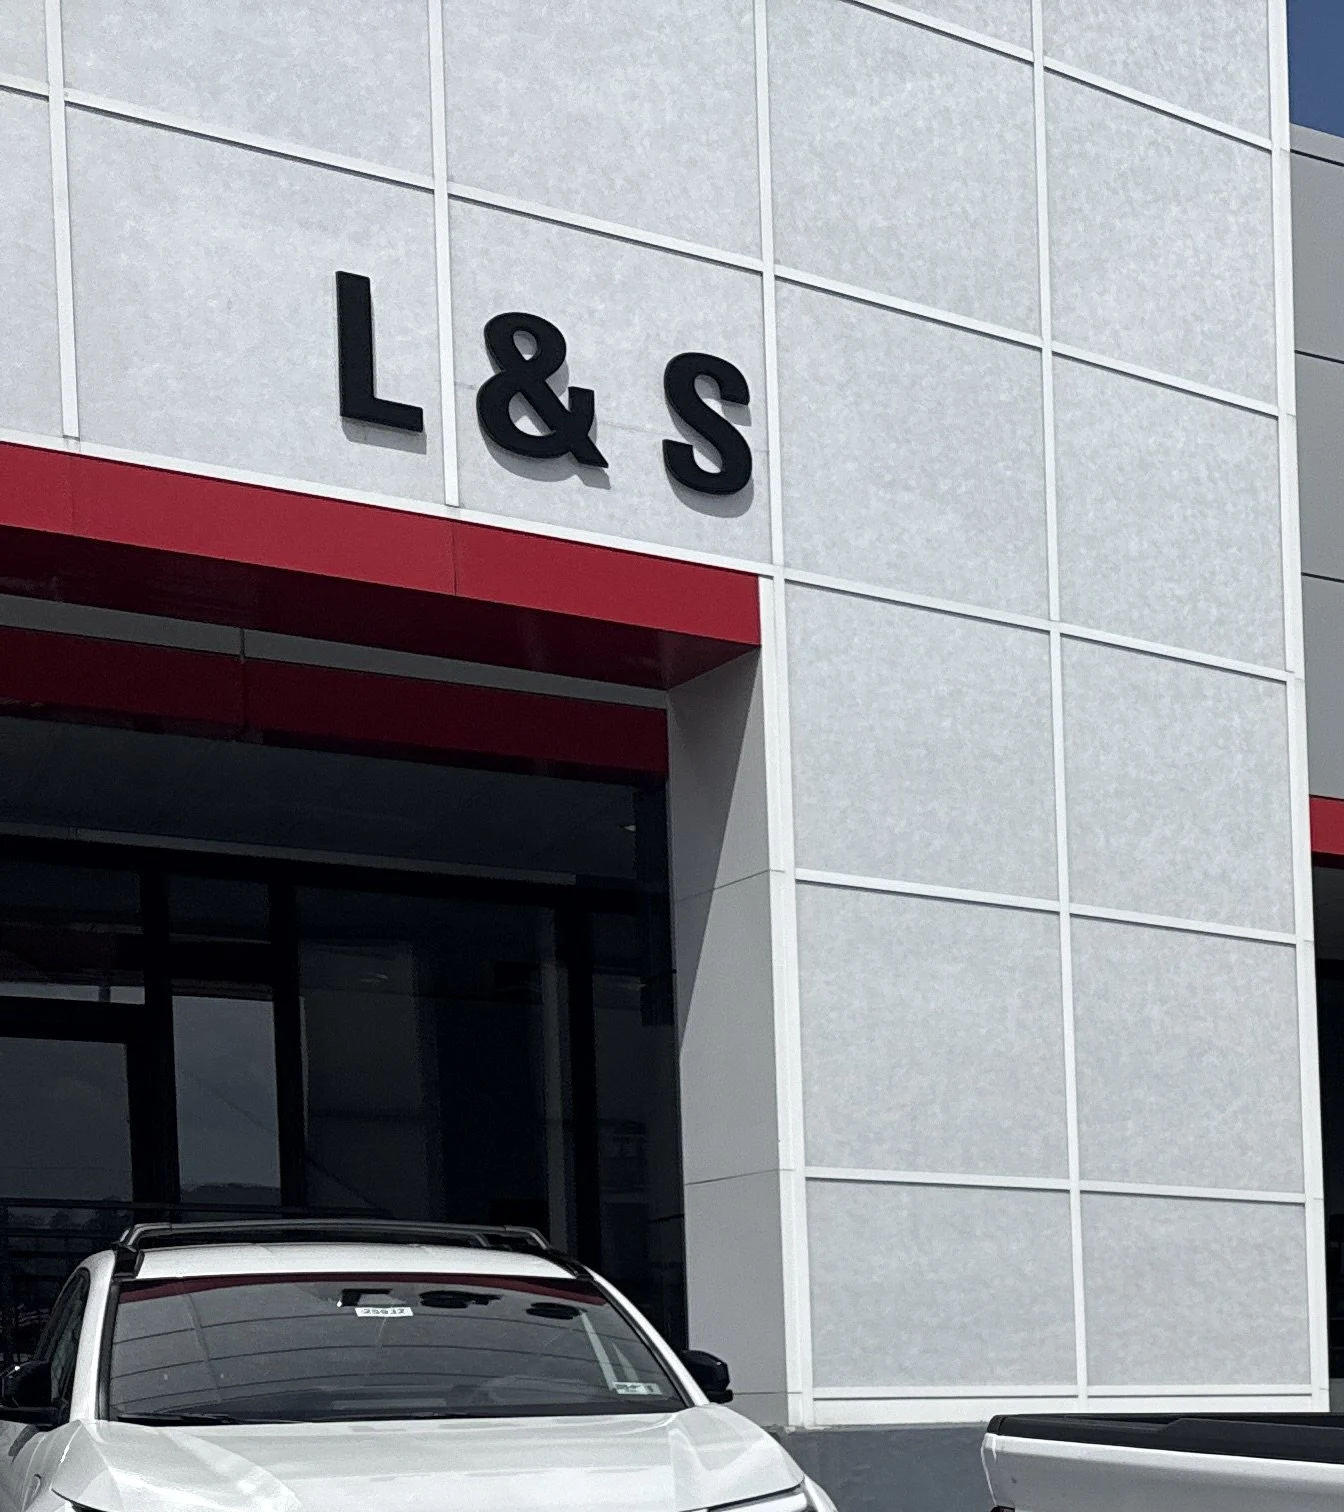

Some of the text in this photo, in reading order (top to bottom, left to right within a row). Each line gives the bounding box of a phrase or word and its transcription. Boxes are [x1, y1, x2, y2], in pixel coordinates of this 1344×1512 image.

[336, 270, 753, 496] L & S
